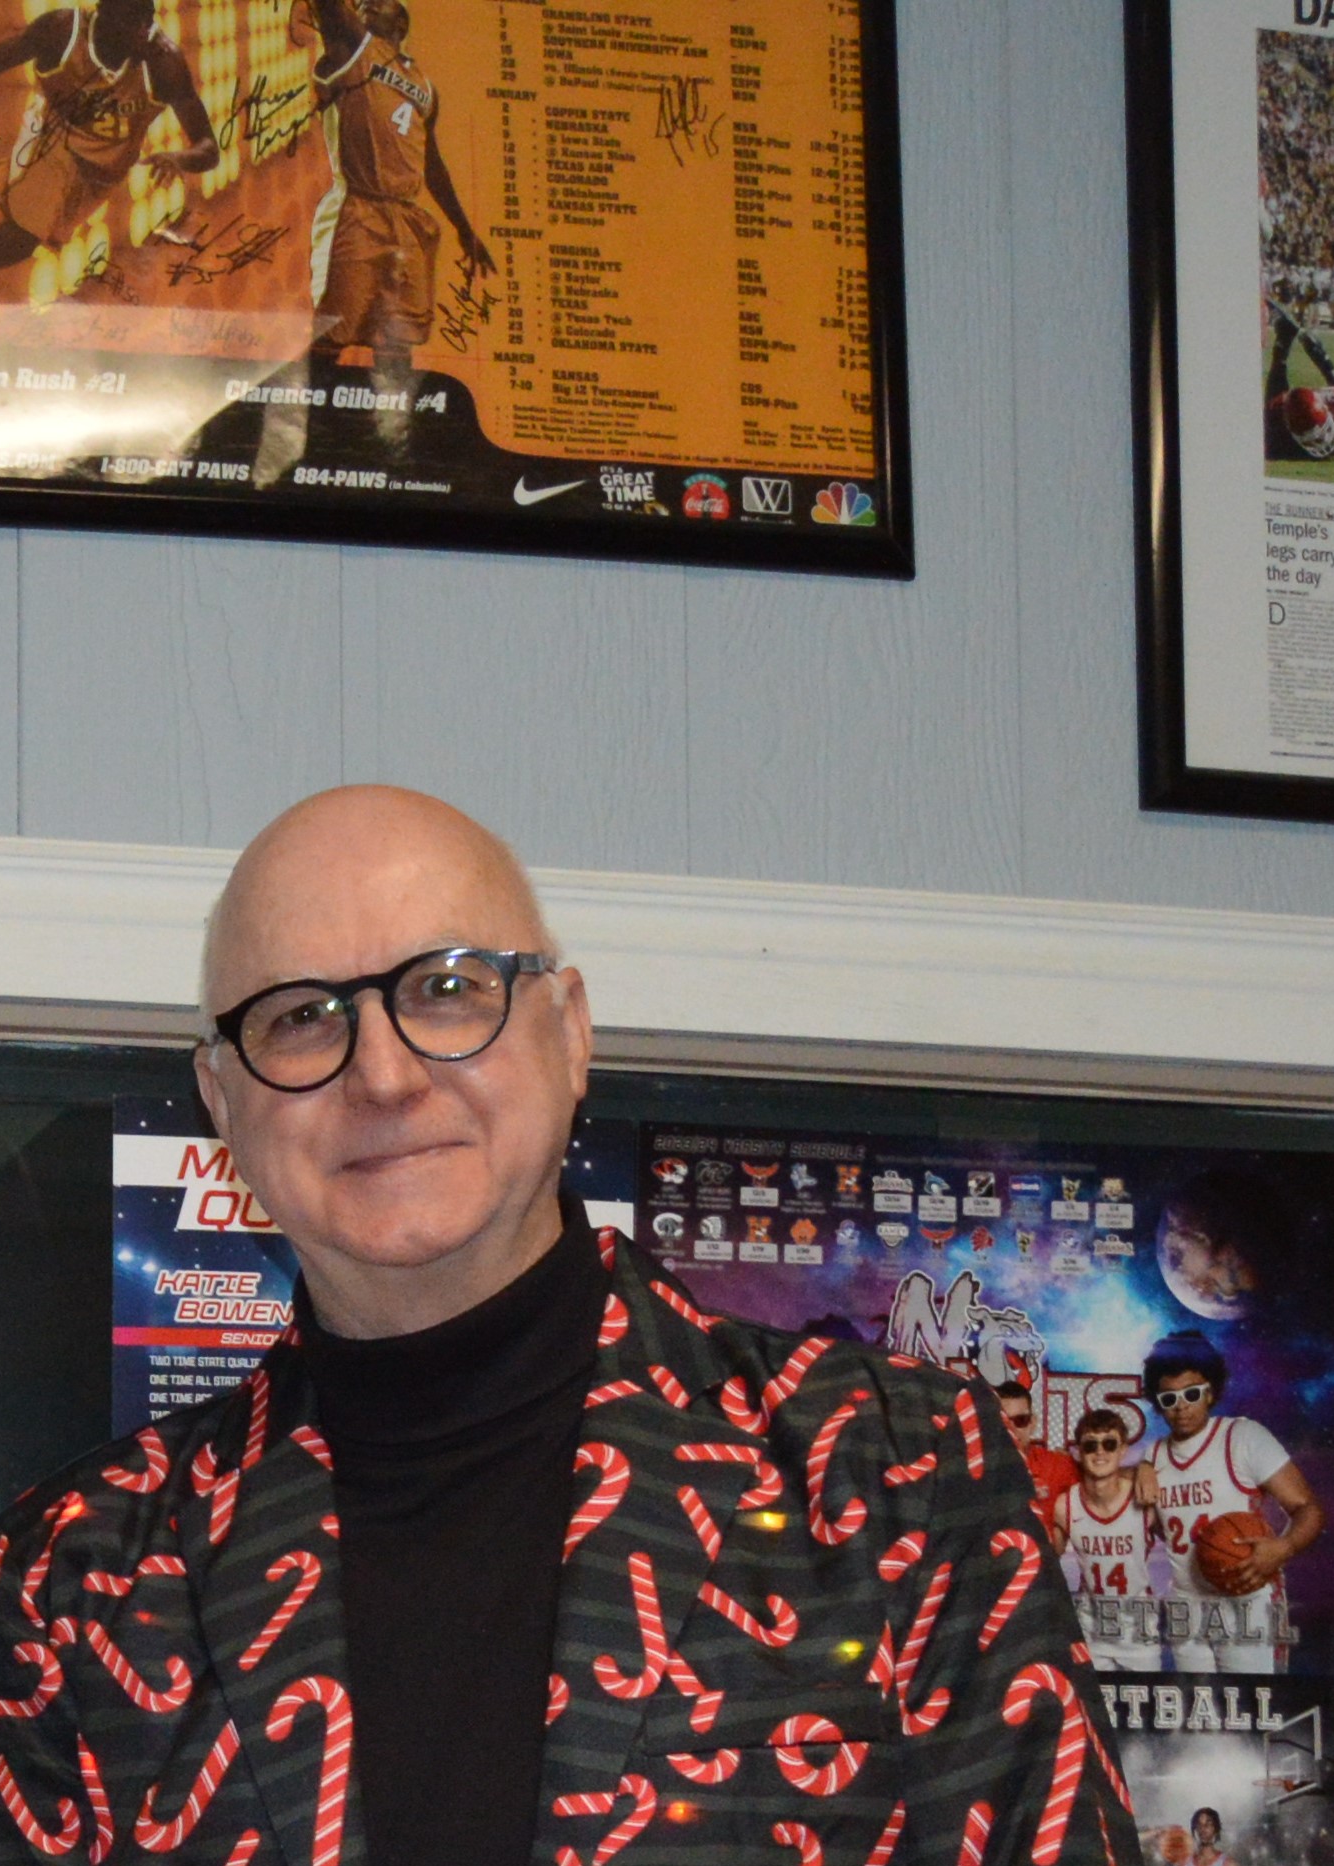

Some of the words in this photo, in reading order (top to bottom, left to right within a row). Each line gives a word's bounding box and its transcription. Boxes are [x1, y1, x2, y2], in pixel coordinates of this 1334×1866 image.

[391, 102, 414, 136] 4
[583, 259, 623, 273] STATE
[493, 351, 536, 365] MARCH
[619, 343, 659, 356] STATE
[16, 367, 77, 391] Rush
[84, 371, 128, 395] #21
[552, 369, 600, 384] KANSAS
[224, 378, 326, 407] Clarence
[332, 386, 408, 412] Gilbert
[415, 391, 447, 414] #4
[100, 456, 193, 478] 1-800-CAT
[196, 461, 251, 482] PAWS
[293, 468, 388, 489] 884-PAWS
[599, 471, 655, 487] GREAT
[602, 484, 656, 503] TIME
[1265, 518, 1329, 541] Temple's
[1266, 541, 1297, 564] legs
[1266, 564, 1291, 582] the
[1295, 567, 1322, 589] day
[155, 1269, 262, 1297] KATIE
[174, 1299, 295, 1326] BOWEN
[220, 1332, 281, 1347] SENIO
[172, 1356, 197, 1368] TIME
[198, 1356, 226, 1369] STATE
[170, 1374, 194, 1386] TIME
[170, 1392, 194, 1404] TIME
[1158, 1480, 1215, 1509] DAWGS
[1080, 1534, 1134, 1557] DAWGS
[1090, 1561, 1129, 1596] 14
